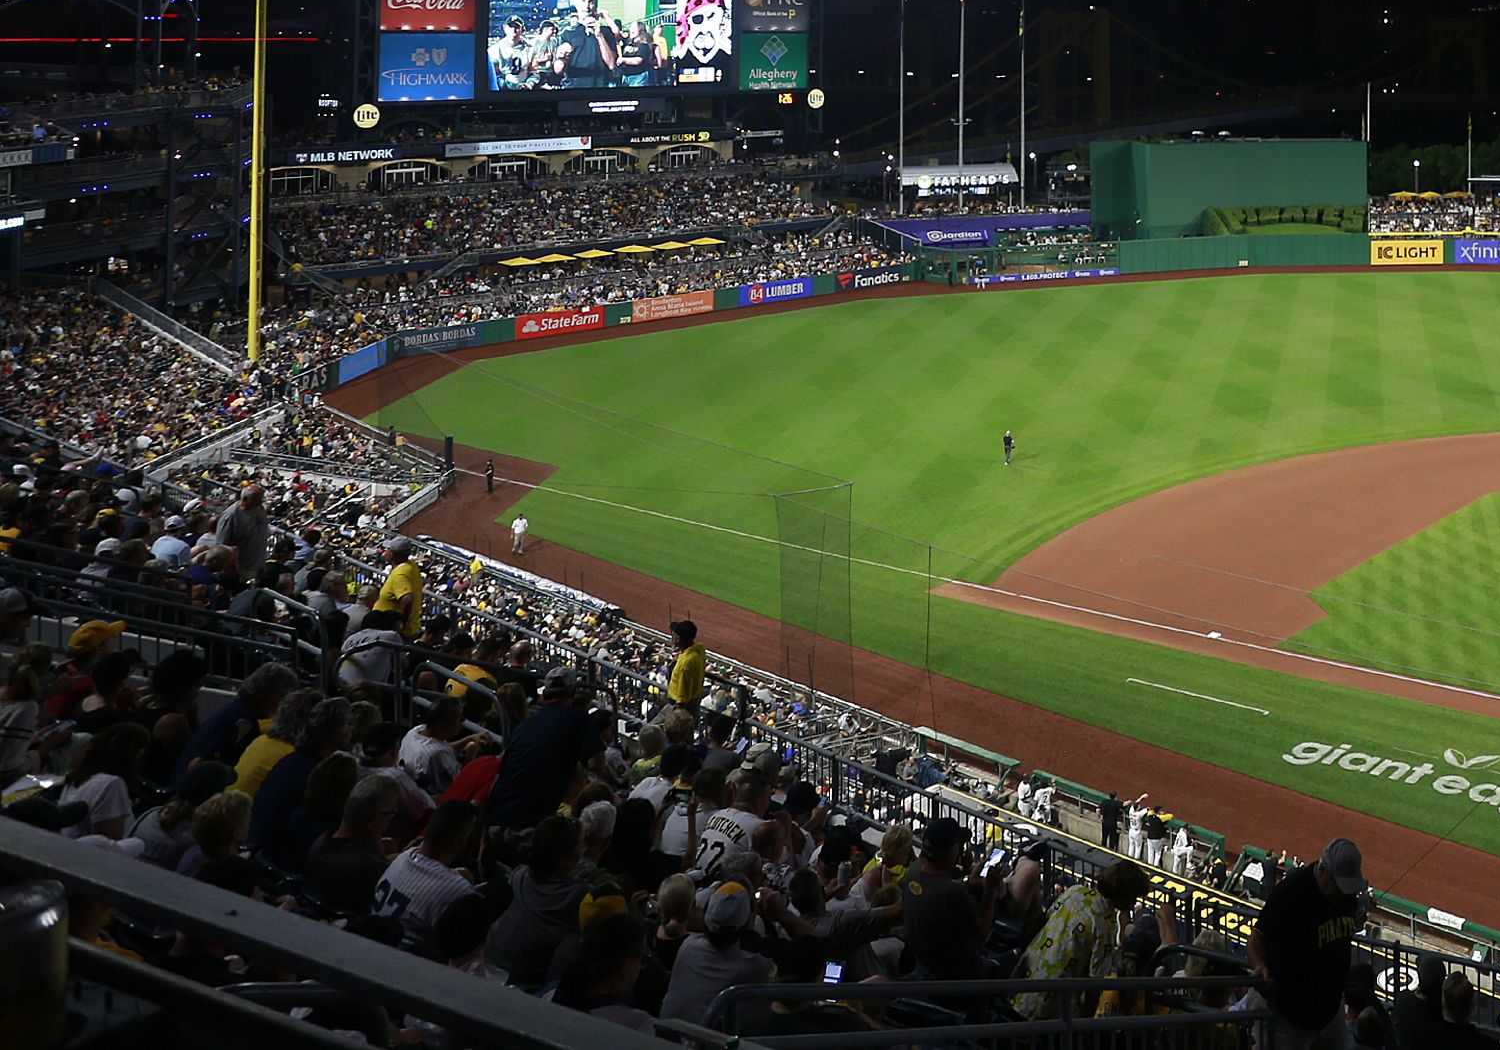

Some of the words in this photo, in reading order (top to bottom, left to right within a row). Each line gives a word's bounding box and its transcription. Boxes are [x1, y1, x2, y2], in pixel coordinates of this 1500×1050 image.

[387, 69, 470, 86] HIGHMARK
[749, 68, 798, 81] Allegheny
[808, 91, 823, 104] Lite
[357, 109, 378, 123] Lite
[672, 134, 696, 142] RUSH
[310, 152, 335, 162] MLB
[338, 148, 394, 161] NETWORK
[934, 176, 956, 186] FAT
[960, 174, 1010, 186] HEAD'S
[928, 230, 982, 242] Guardian
[1377, 246, 1394, 259] IC
[1396, 246, 1437, 259] LIGHT
[854, 271, 900, 288] Fanatics
[750, 287, 763, 300] 84
[766, 282, 803, 298] LUMBER
[404, 332, 438, 347] BORDAS
[442, 326, 476, 342] BORDAS
[1281, 741, 1434, 784] giant
[374, 878, 411, 917] 27
[1072, 922, 1085, 934] P
[1040, 938, 1053, 950] P
